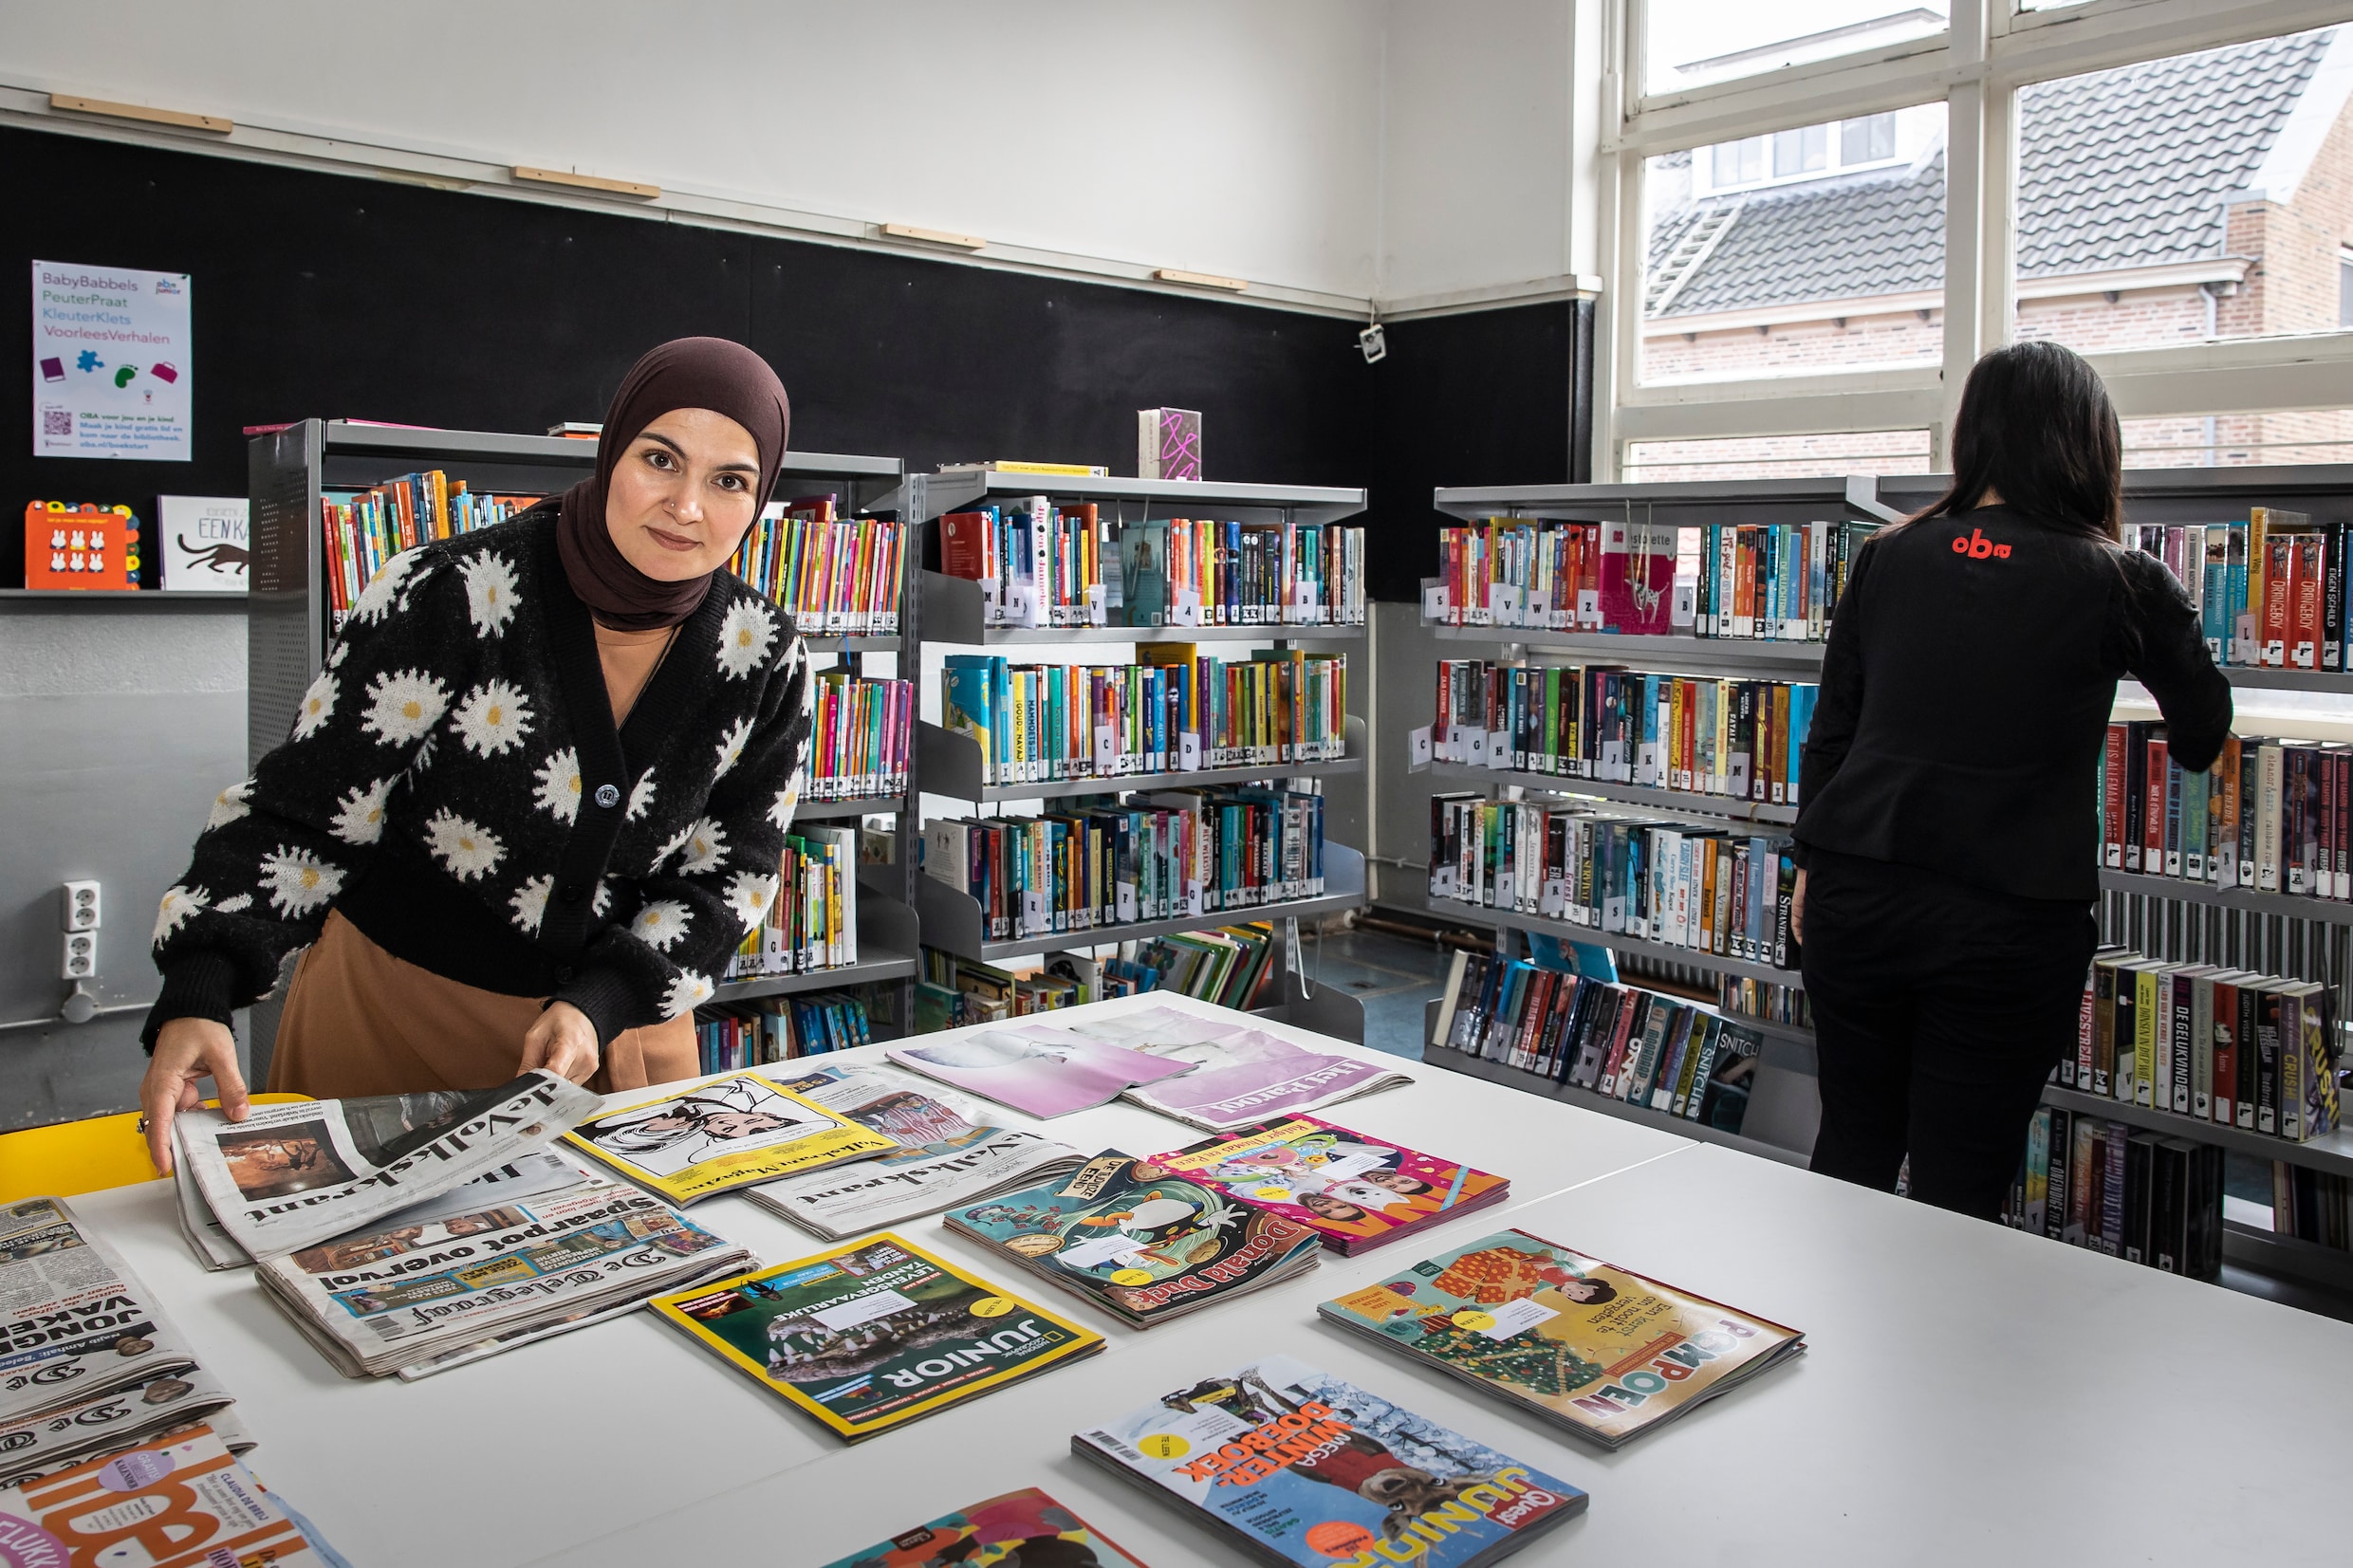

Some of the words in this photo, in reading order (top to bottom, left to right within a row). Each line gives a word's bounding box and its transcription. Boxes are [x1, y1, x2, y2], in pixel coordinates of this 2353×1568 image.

[43, 272, 139, 291] BabyBabbels
[43, 290, 128, 308] PeuterPraat
[43, 308, 131, 324] KleuterKlets
[44, 324, 170, 344] VoorleesVerhalen
[1036, 506, 1045, 523] Jip
[198, 518, 232, 539] EEN
[1953, 528, 2011, 559] oba
[2251, 558, 2262, 575] Weg
[2327, 567, 2338, 593] EIGEN
[985, 592, 991, 601] M
[1013, 598, 1019, 607] N
[1303, 596, 1308, 604] B
[1437, 596, 1442, 605] S
[1504, 600, 1510, 610] V
[1091, 601, 1097, 610] V
[1185, 606, 1191, 616] A
[1533, 604, 1541, 614] W
[1585, 602, 1592, 612] Z
[1682, 600, 1688, 611] B
[2270, 581, 2286, 630] ORANGEBOY
[2299, 581, 2316, 631] ORANGEBOY
[2325, 594, 2336, 628] SCHULD
[2244, 628, 2250, 639] L
[1103, 739, 1108, 749] C
[1420, 740, 1425, 749] C
[1454, 733, 1458, 742] E
[1474, 740, 1480, 749] G
[2108, 732, 2120, 747] DIT
[1186, 745, 1192, 753] D
[1496, 747, 1503, 755] H
[1611, 754, 1617, 764] J
[1645, 754, 1652, 765] K
[1733, 766, 1742, 776] M
[2105, 760, 2119, 806] ALLEMAAL
[1680, 842, 1690, 865] CARRY
[1441, 875, 1448, 883] N
[1582, 860, 1591, 901] SURVIVAL
[1679, 866, 1689, 881] SLEE
[1503, 880, 1509, 890] P
[1552, 886, 1559, 895] R
[1123, 893, 1128, 904] F
[1190, 890, 1195, 899] G
[1613, 906, 1619, 916] S
[1776, 895, 1791, 950] STRANDERS
[2139, 1006, 2151, 1034] DANSEN
[2177, 1005, 2190, 1021] DE
[1719, 1033, 1759, 1057] SNITCH
[1585, 1056, 1594, 1067] W
[2139, 1045, 2150, 1063] DIEP
[2218, 1052, 2230, 1072] Anna
[1306, 1058, 1366, 1088] Het
[1692, 1047, 1713, 1098] SNITCH
[2126, 1072, 2133, 1084] V
[506, 1081, 559, 1121] de
[1221, 1077, 1307, 1114] Parool
[777, 1139, 884, 1168] Volkskrant
[244, 1113, 518, 1226] Volkskrant
[798, 1141, 1023, 1206] Volkskrant
[1104, 1157, 1123, 1173] DE
[680, 1160, 778, 1193] Magazine
[1072, 1165, 1098, 1191] EEND
[2049, 1167, 2065, 1211] ONEINDIGE
[548, 1196, 601, 1212] uitgegeven
[554, 1205, 577, 1216] loon
[578, 1199, 602, 1209] meer
[482, 1197, 657, 1253] Spaarpot
[533, 1248, 571, 1263] MIRTHE
[537, 1246, 600, 1267] DEPRESSIEVE
[542, 1249, 604, 1271] LICHTPUNTJE
[604, 1247, 666, 1273] De
[1198, 1221, 1301, 1288] Donald
[318, 1245, 476, 1291] overvol
[463, 1269, 485, 1282] MET
[485, 1260, 522, 1277] ZEGE
[861, 1261, 926, 1287] TANDEN
[1136, 1271, 1145, 1280] TE
[61, 1292, 85, 1302] ons
[773, 1265, 936, 1322] LEVENSGEVAARLIJKE
[1128, 1273, 1216, 1306] Duck
[64, 1299, 81, 1308] de
[414, 1269, 605, 1328] Telegraaf
[1641, 1295, 1657, 1308] om
[11, 1301, 58, 1317] zorgen
[1585, 1294, 1637, 1325] vergeten
[1609, 1304, 1640, 1328] nooit
[1652, 1301, 1673, 1318] Een
[1458, 1317, 1478, 1327] LEEN
[1595, 1322, 1611, 1335] te
[1615, 1316, 1650, 1338] kerst
[88, 1331, 120, 1345] Najib
[880, 1319, 1042, 1388] JUNIOR
[1000, 1336, 1047, 1358] GEOGRAPHIC
[1016, 1339, 1051, 1358] NATIONAL
[5, 1356, 86, 1392] De
[1567, 1319, 1762, 1419] POMPOEN
[1171, 1401, 1335, 1483] DOEBOEK
[1294, 1431, 1352, 1467] MEGA
[1214, 1418, 1355, 1487] WINTER-
[220, 1472, 244, 1499] CLAUDIA
[242, 1495, 252, 1506] DE
[1494, 1489, 1556, 1526] Quest
